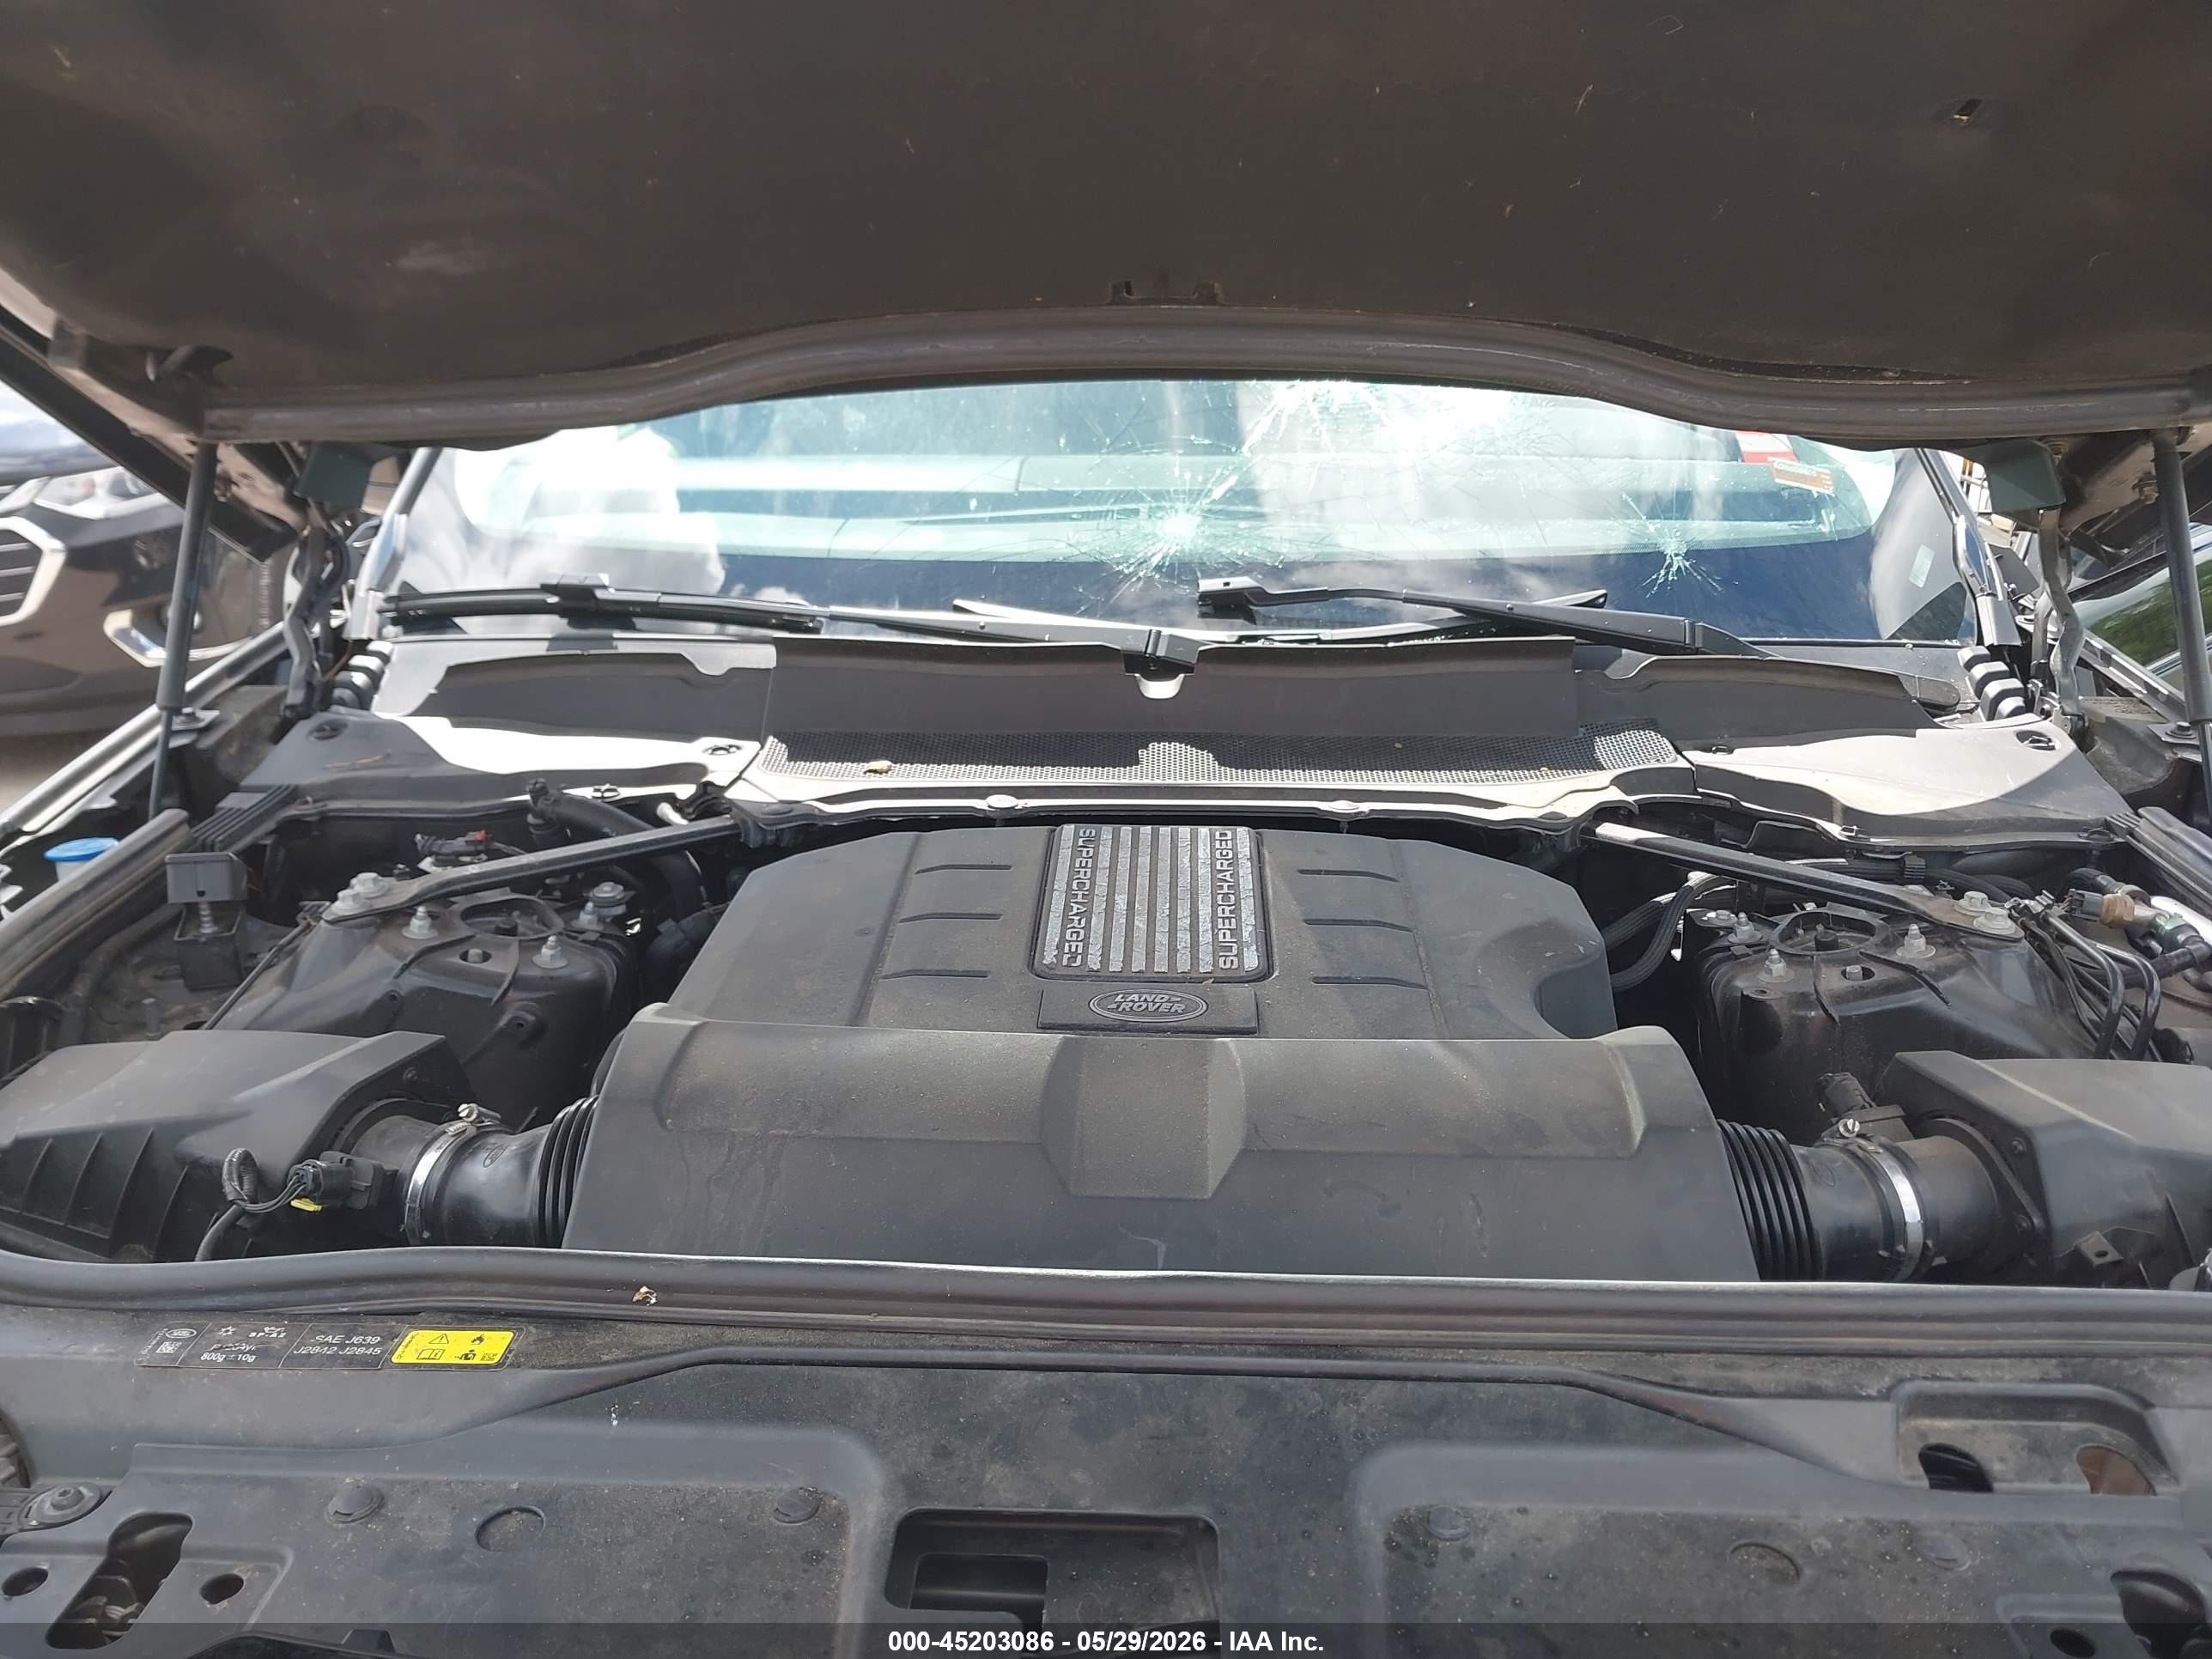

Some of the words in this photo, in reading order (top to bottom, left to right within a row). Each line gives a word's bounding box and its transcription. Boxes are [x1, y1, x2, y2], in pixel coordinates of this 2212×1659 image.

[1061, 827, 1097, 968] SUPERCHARGED
[1215, 830, 1239, 970] SUPERCHARGED
[1115, 993, 1172, 1003] LAND
[1118, 1002, 1186, 1013] ROVER
[312, 1335, 343, 1344] SAE
[344, 1335, 380, 1345] J639
[293, 1346, 337, 1355] J2842
[338, 1346, 382, 1356] J2845
[200, 1352, 227, 1363] 800g
